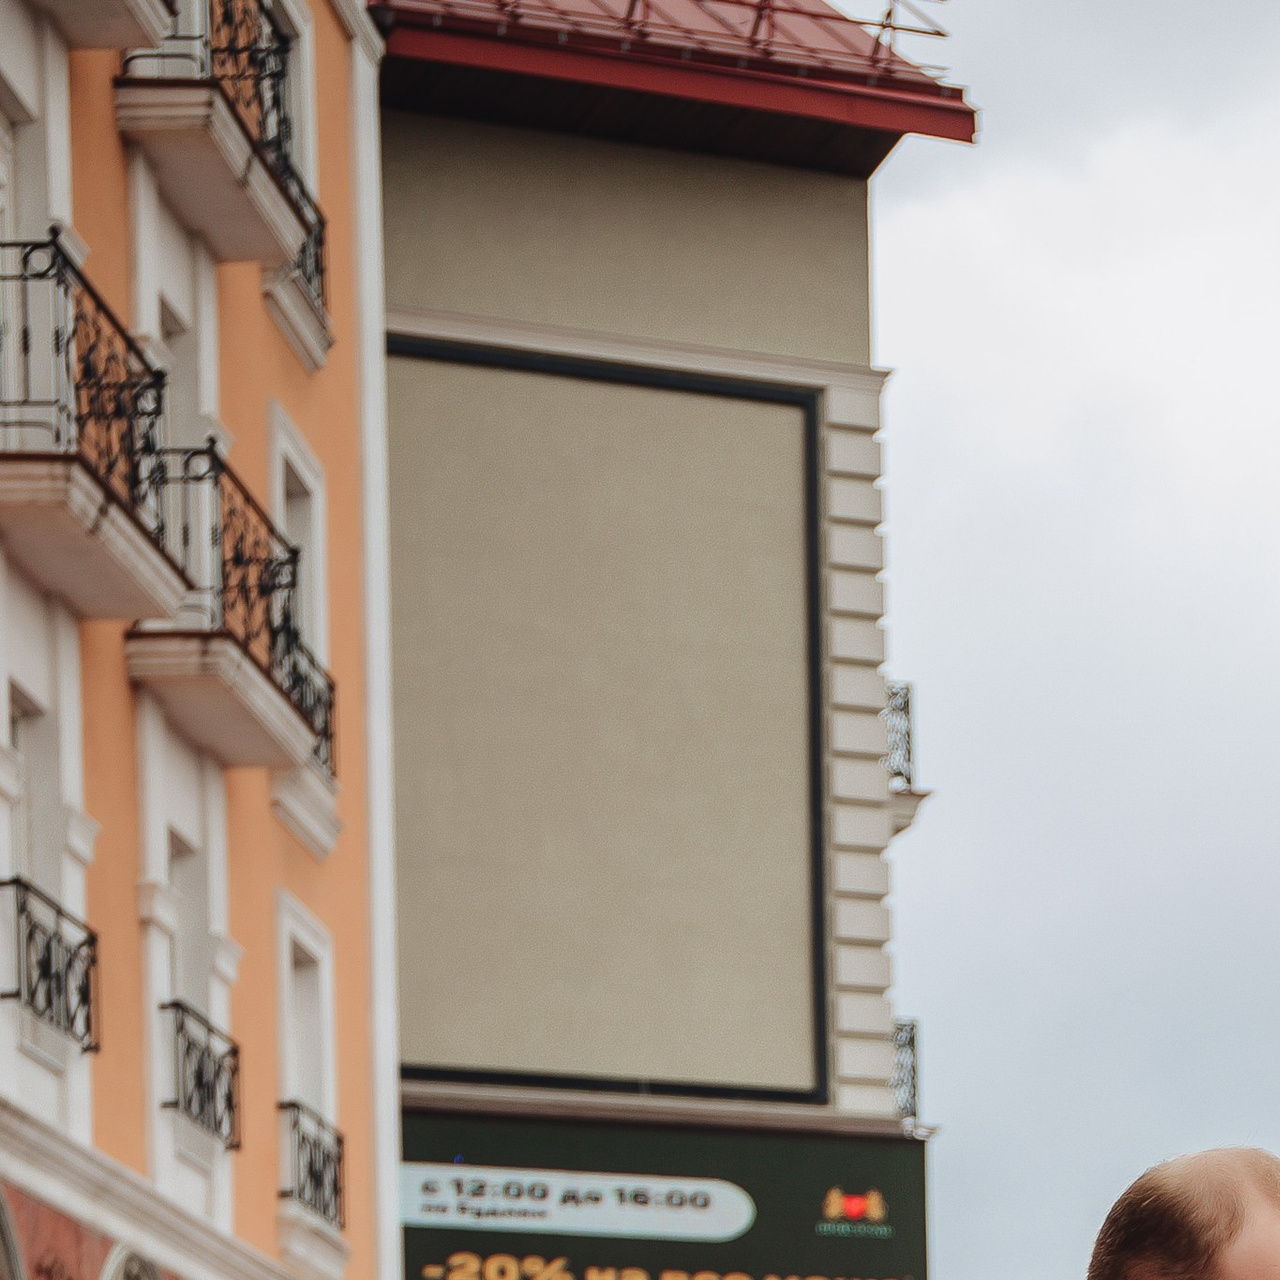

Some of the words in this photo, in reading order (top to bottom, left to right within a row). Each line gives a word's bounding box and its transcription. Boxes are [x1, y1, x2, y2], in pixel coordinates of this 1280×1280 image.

[451, 1177, 549, 1202] 12:00
[559, 1188, 603, 1207] до
[614, 1187, 712, 1210] 16:00
